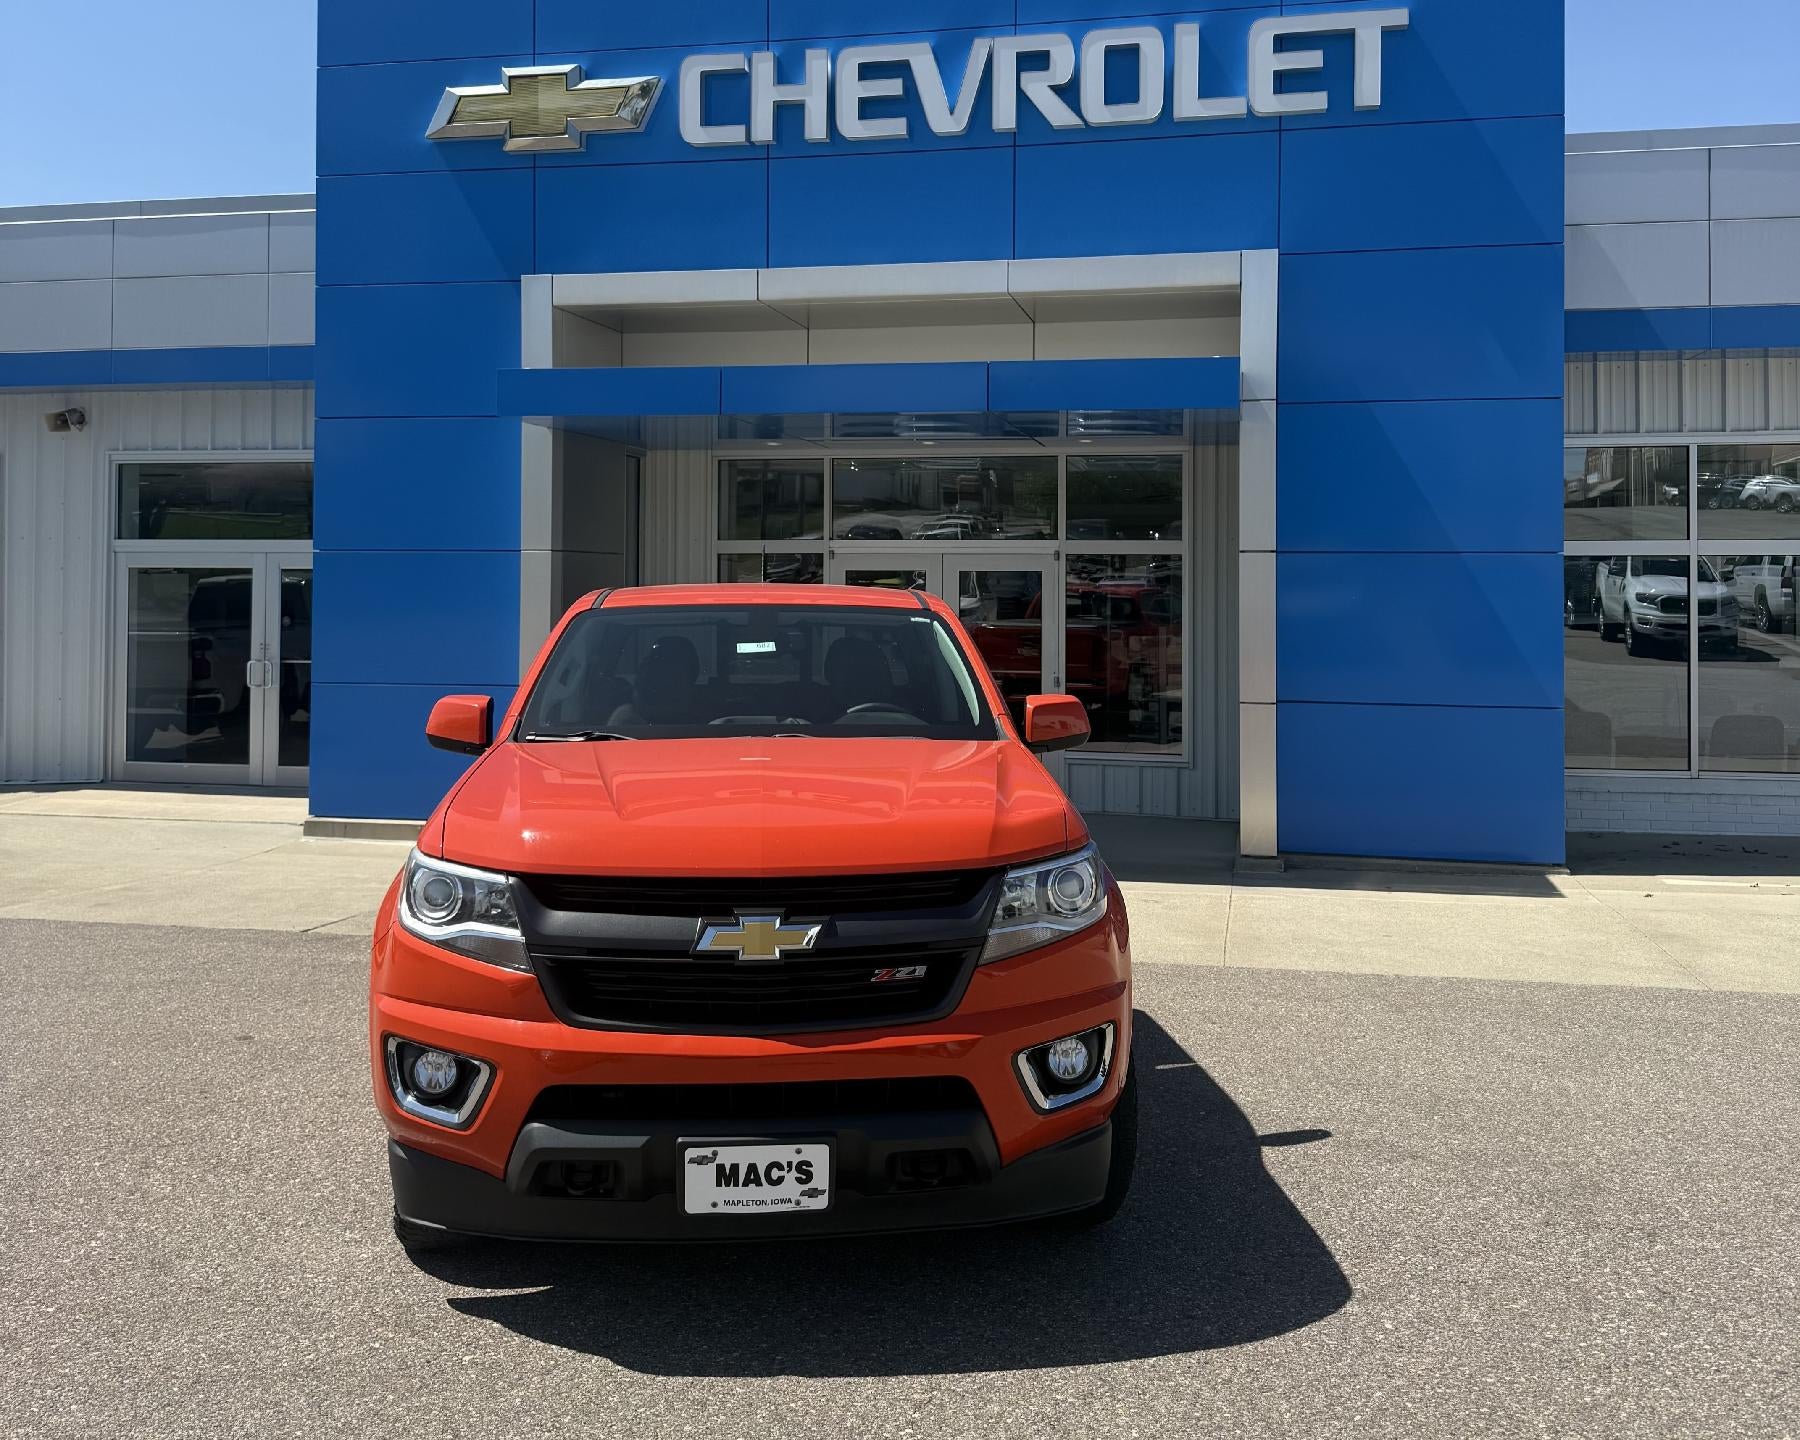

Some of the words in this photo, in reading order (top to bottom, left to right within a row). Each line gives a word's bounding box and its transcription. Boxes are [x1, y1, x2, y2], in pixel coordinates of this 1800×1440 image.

[679, 8, 1409, 147] CHEVROLET
[871, 966, 928, 982] Z71
[715, 1160, 814, 1188] MAC'S
[723, 1199, 770, 1207] MAPLETON,
[770, 1197, 793, 1206] IOWA
